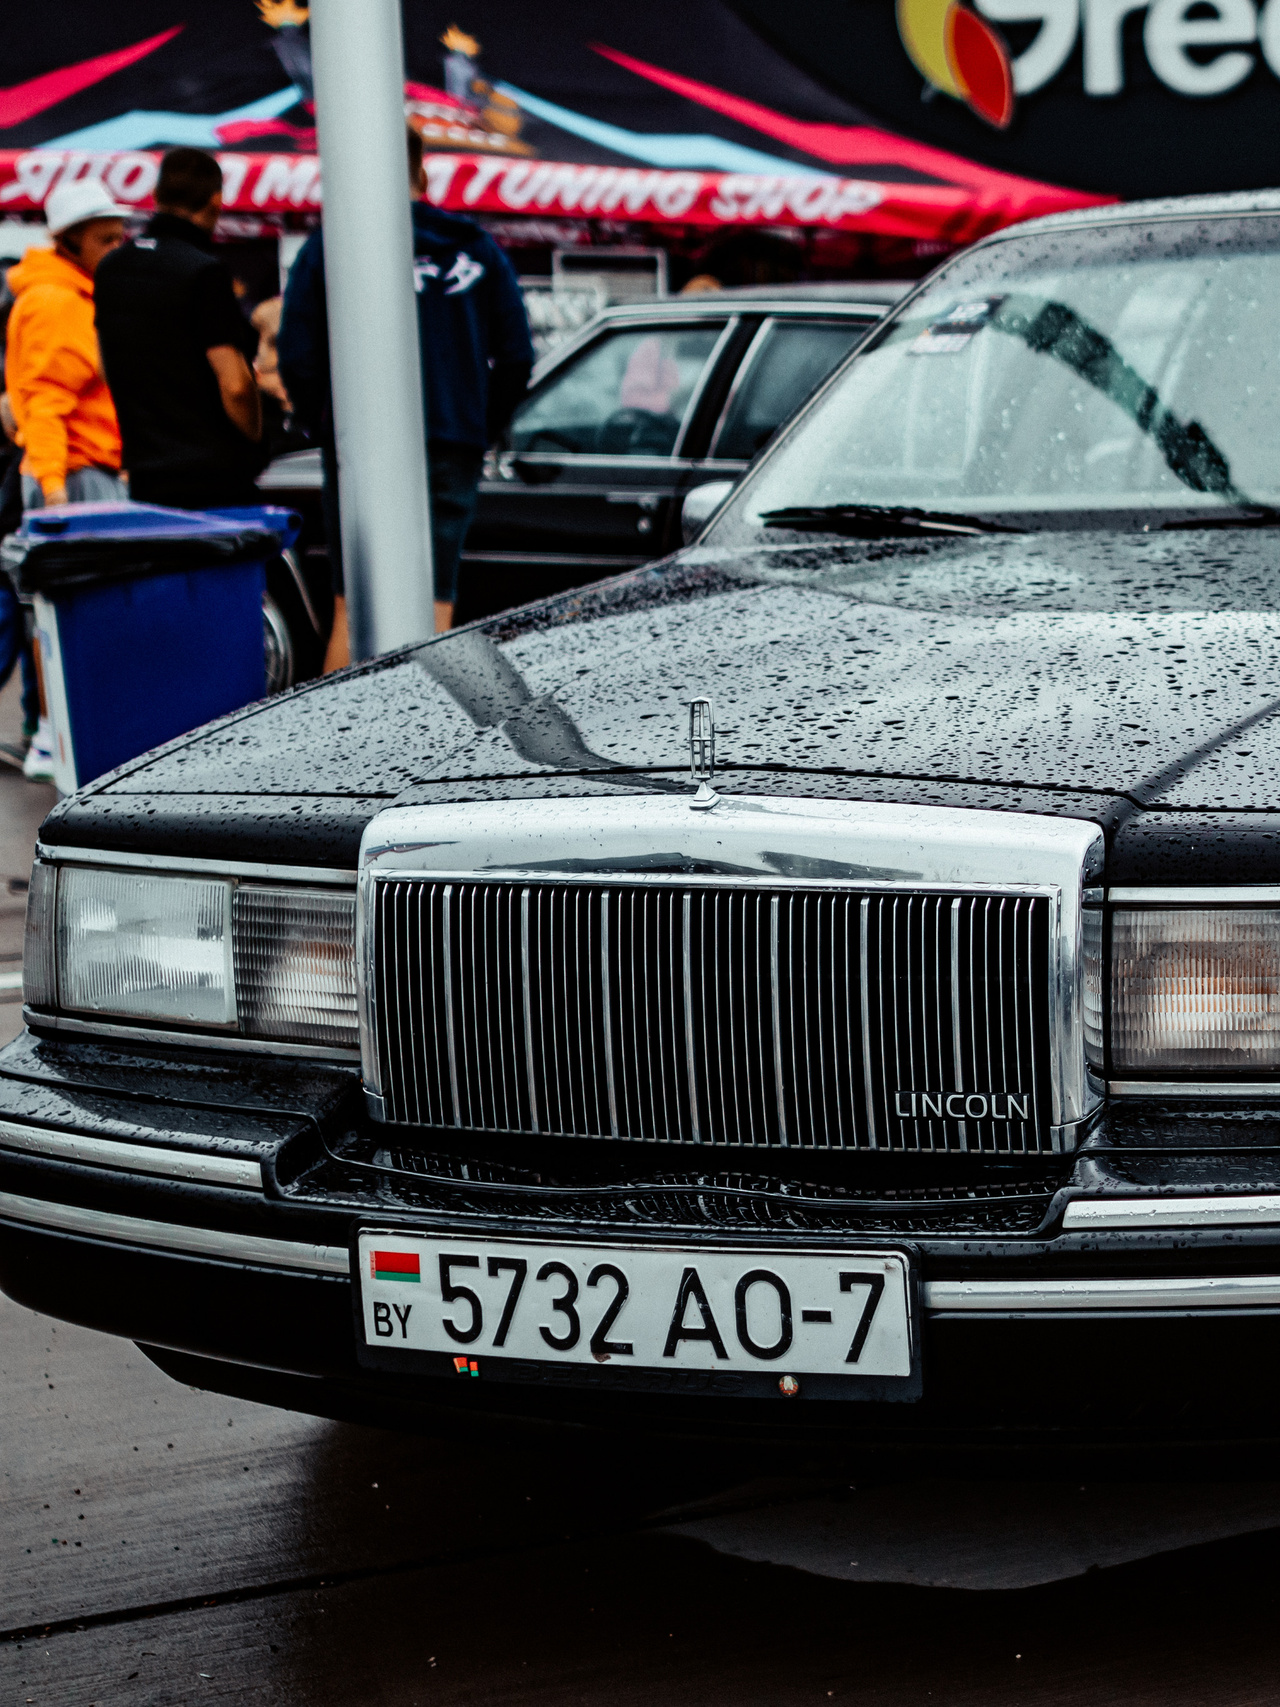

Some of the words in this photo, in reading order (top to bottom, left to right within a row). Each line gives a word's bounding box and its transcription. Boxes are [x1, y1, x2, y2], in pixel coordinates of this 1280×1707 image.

[462, 157, 702, 218] TUNING
[709, 173, 882, 223] SHOP
[895, 1093, 1029, 1120] LINCOLN
[372, 1301, 413, 1339] BY
[437, 1252, 634, 1356] 5732
[662, 1266, 886, 1364] AO-7
